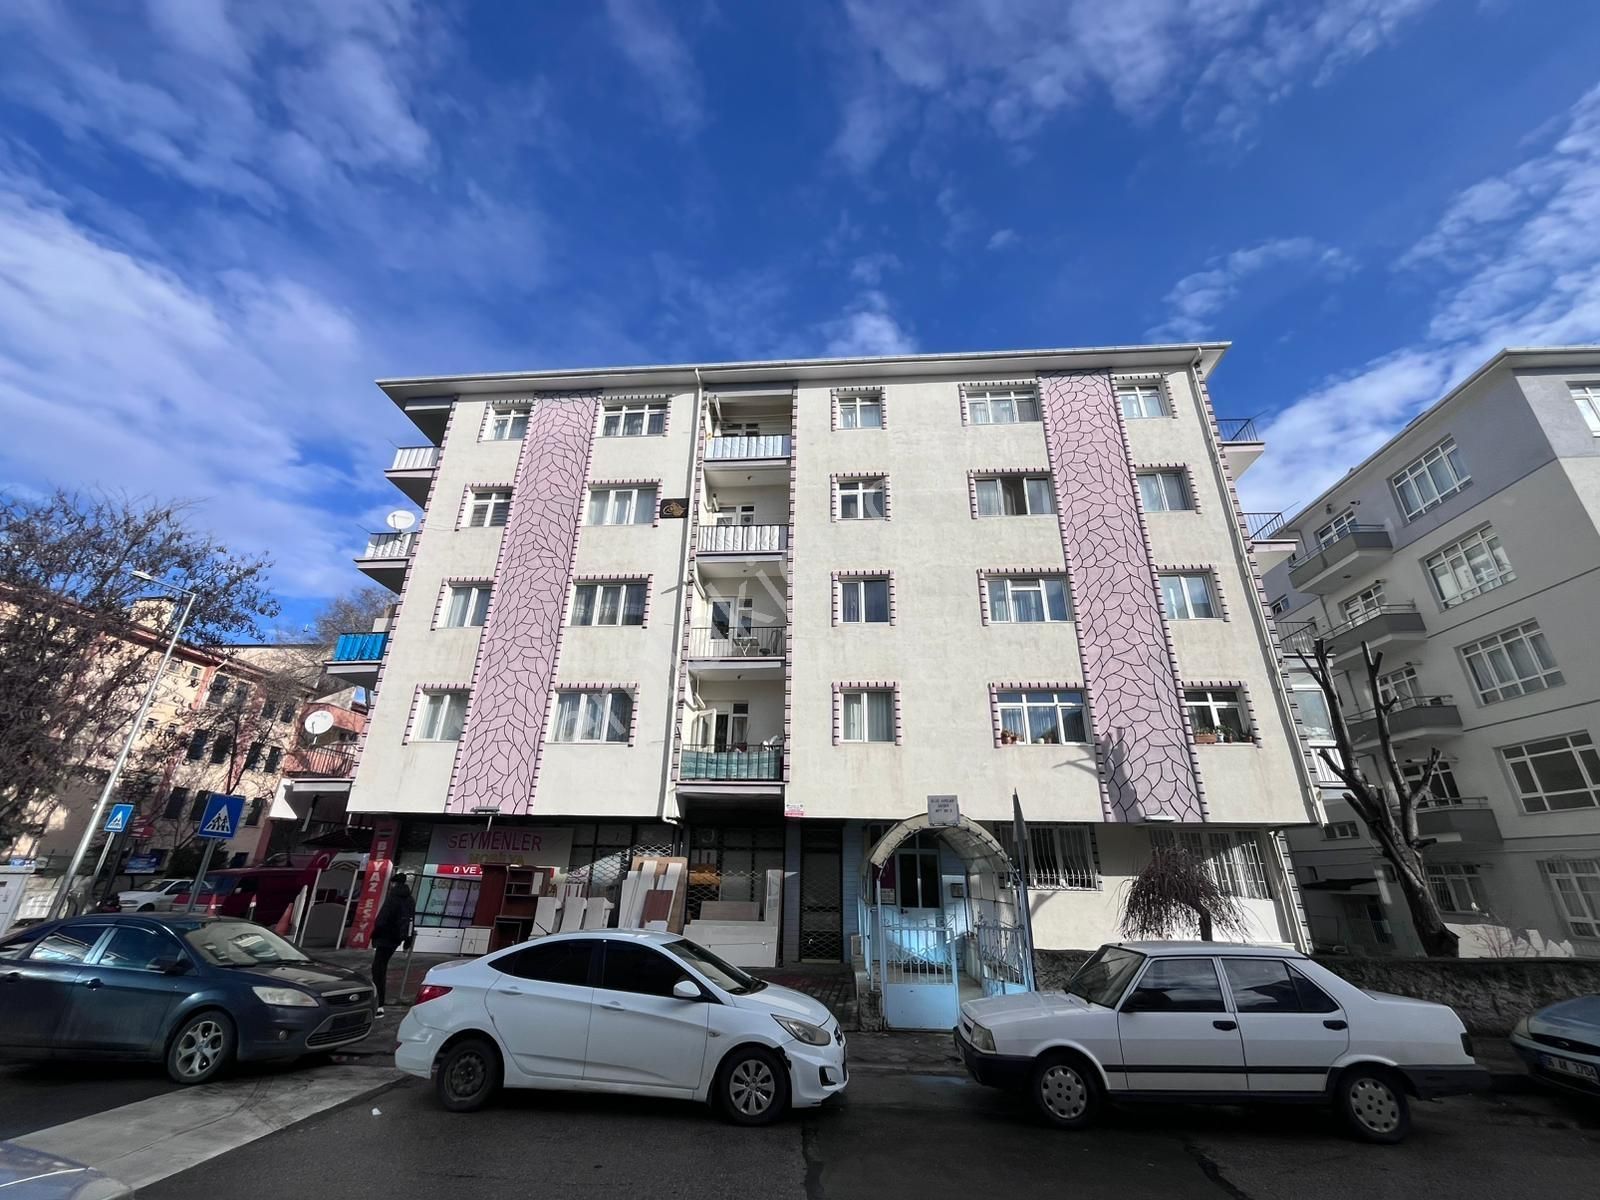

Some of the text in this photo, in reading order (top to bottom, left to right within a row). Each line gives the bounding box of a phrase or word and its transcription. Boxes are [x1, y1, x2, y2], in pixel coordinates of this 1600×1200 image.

[447, 830, 542, 852] SEYMENLER
[368, 840, 388, 892] BEYAZ
[462, 866, 477, 874] VE
